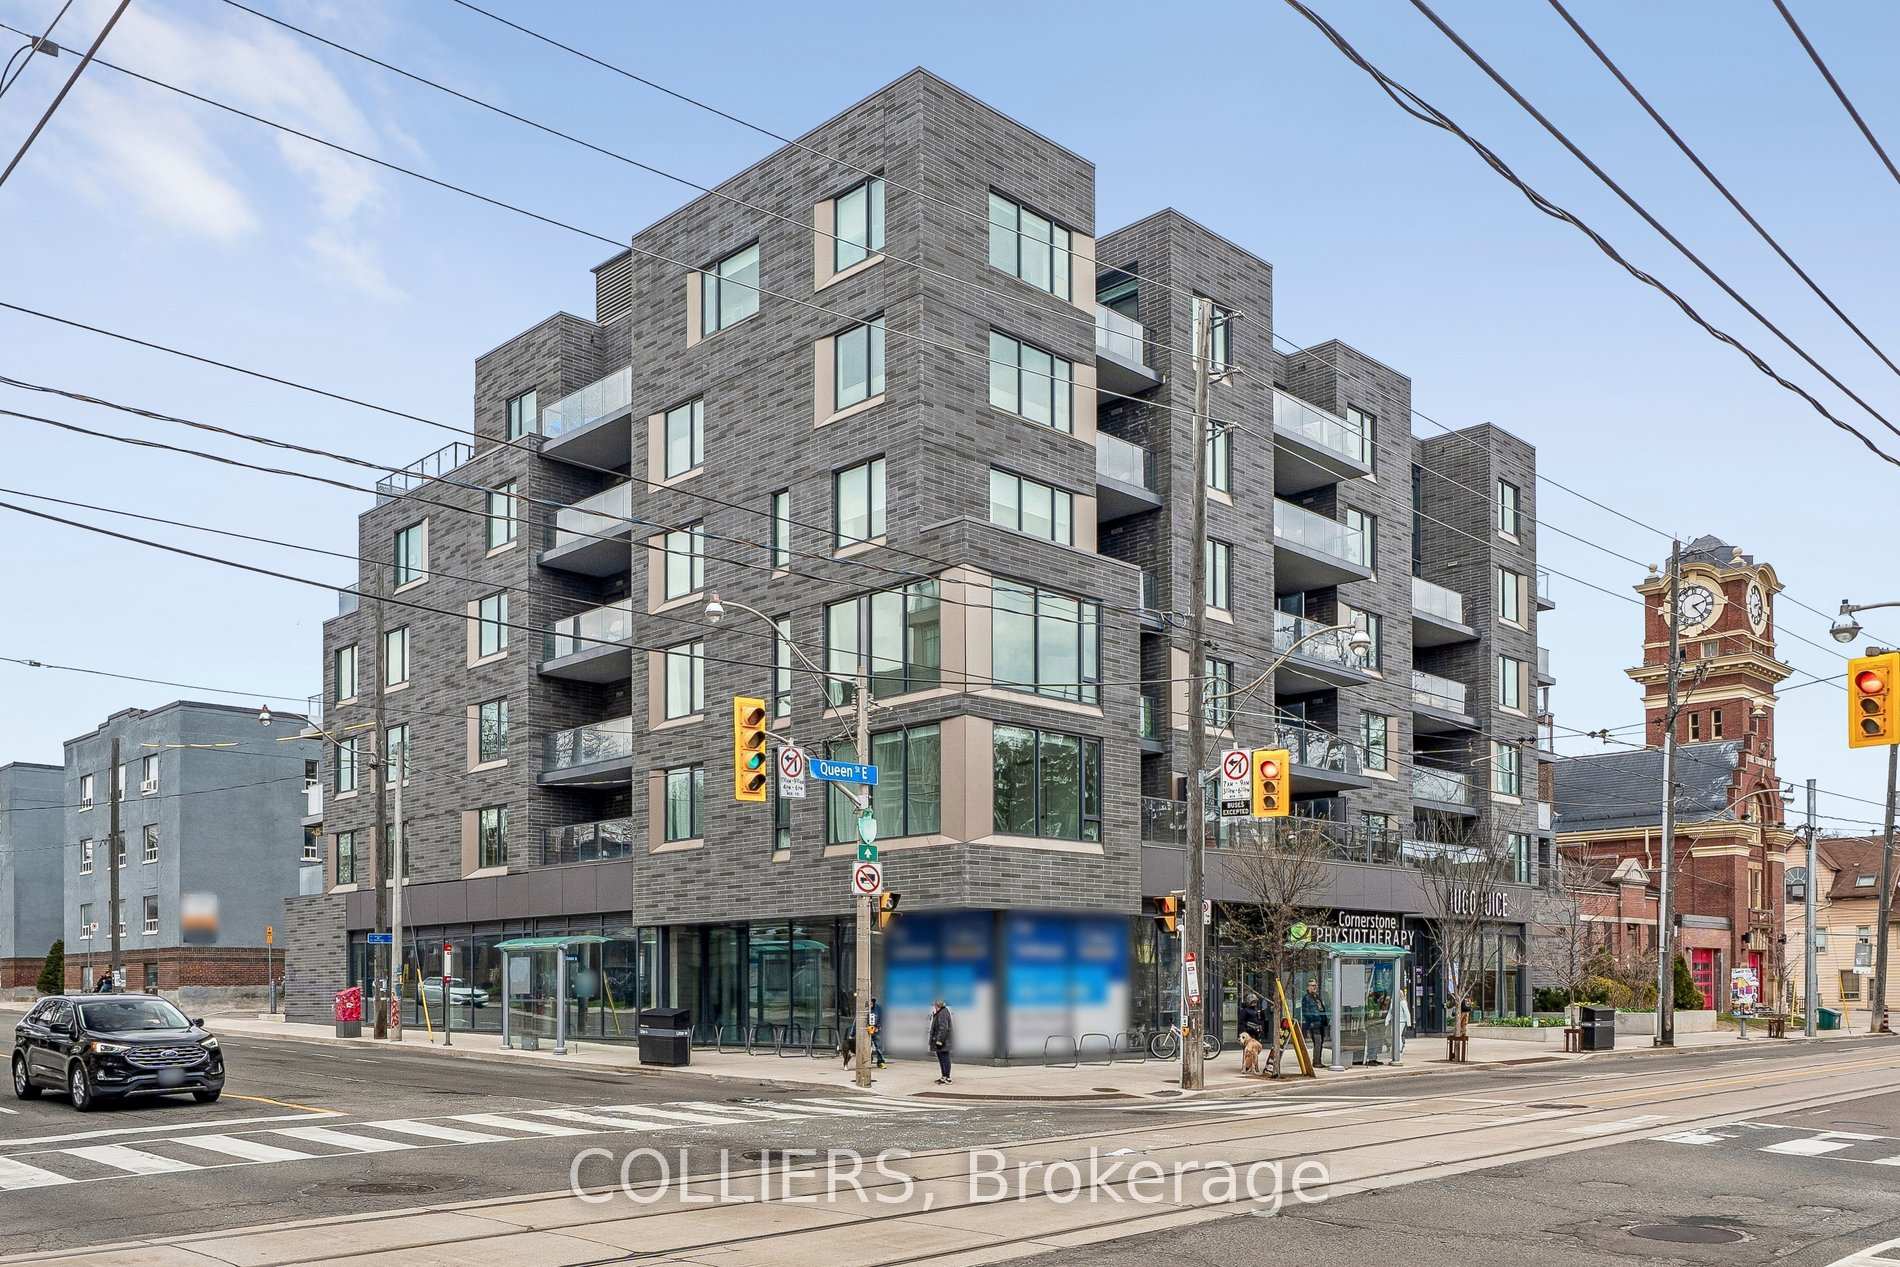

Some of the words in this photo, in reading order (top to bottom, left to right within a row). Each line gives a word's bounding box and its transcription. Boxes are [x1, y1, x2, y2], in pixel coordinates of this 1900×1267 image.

[820, 762, 853, 777] Queen
[862, 766, 868, 779] E
[1480, 892, 1508, 917] UICE
[1338, 911, 1396, 929] Cornerstone
[1316, 927, 1415, 946] PHYSIOTHERAPY
